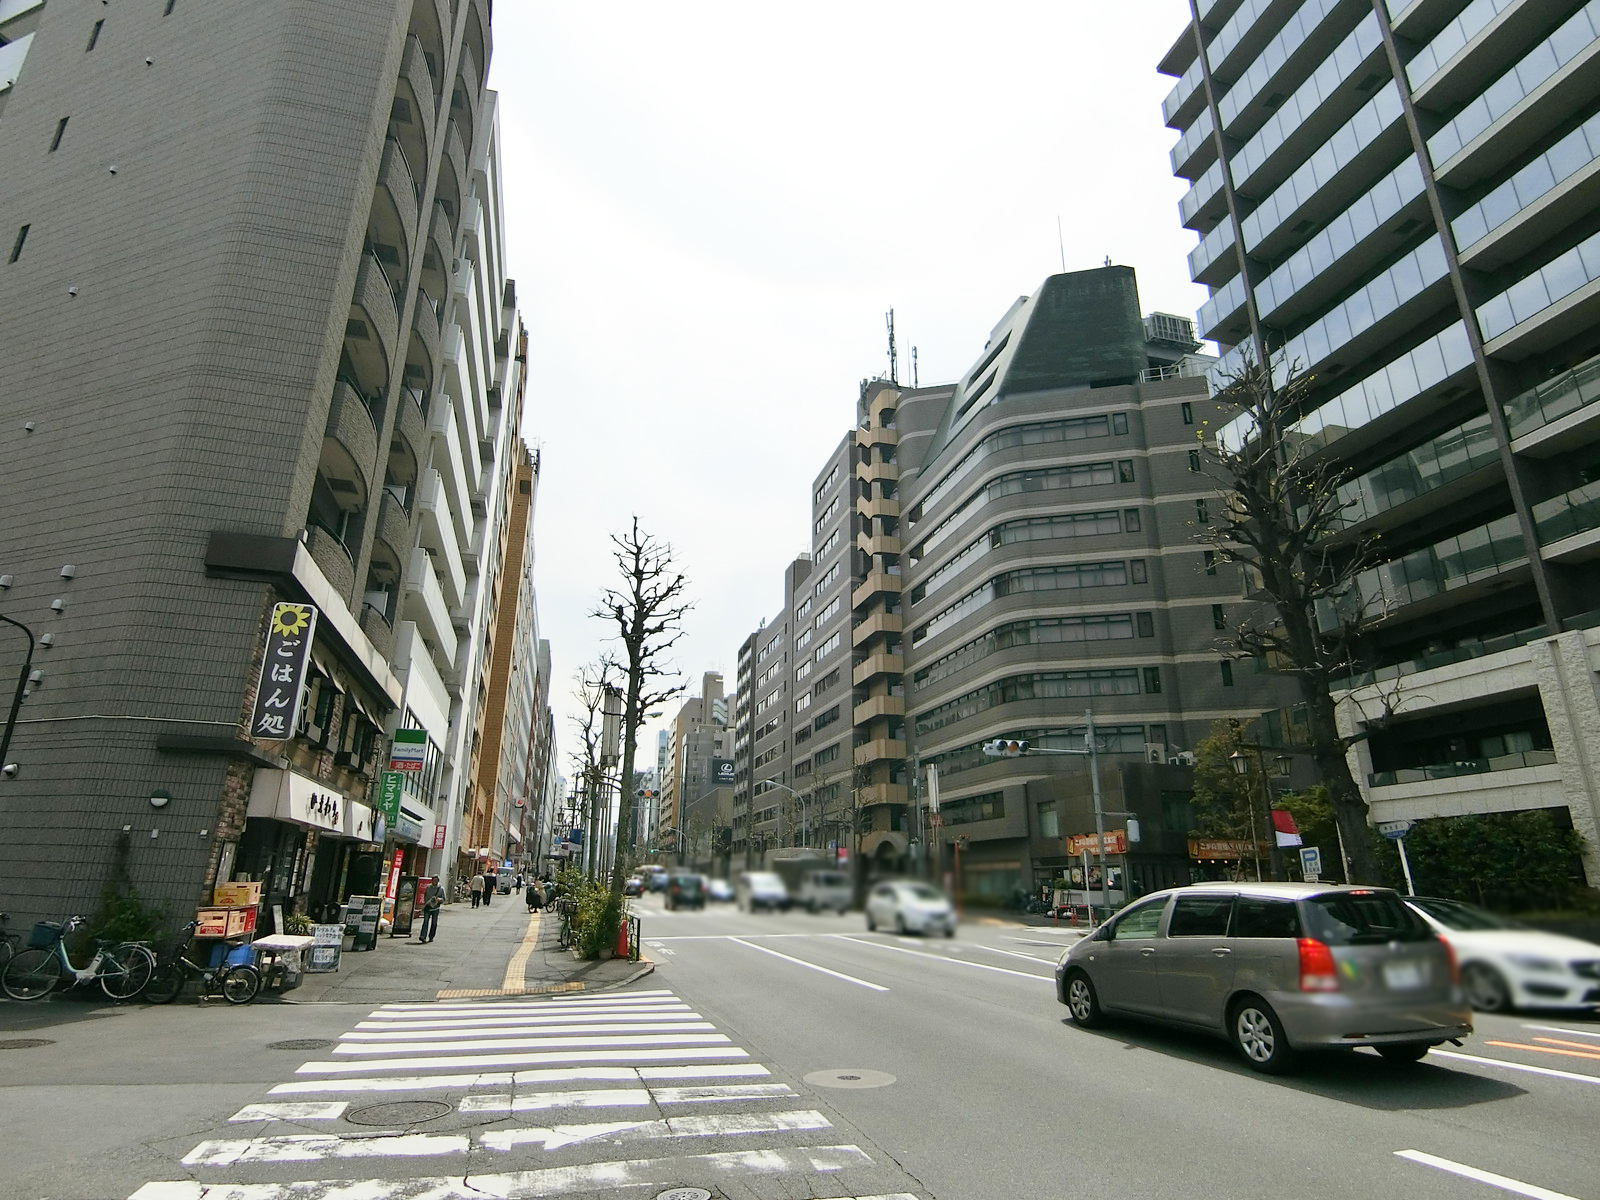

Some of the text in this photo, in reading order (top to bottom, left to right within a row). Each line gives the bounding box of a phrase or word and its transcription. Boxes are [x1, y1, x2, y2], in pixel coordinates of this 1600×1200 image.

[257, 639, 301, 734] ごはん処
[393, 746, 424, 755] FamilyMart
[383, 774, 397, 811] ヒマラヤ
[1302, 849, 1318, 873] P
